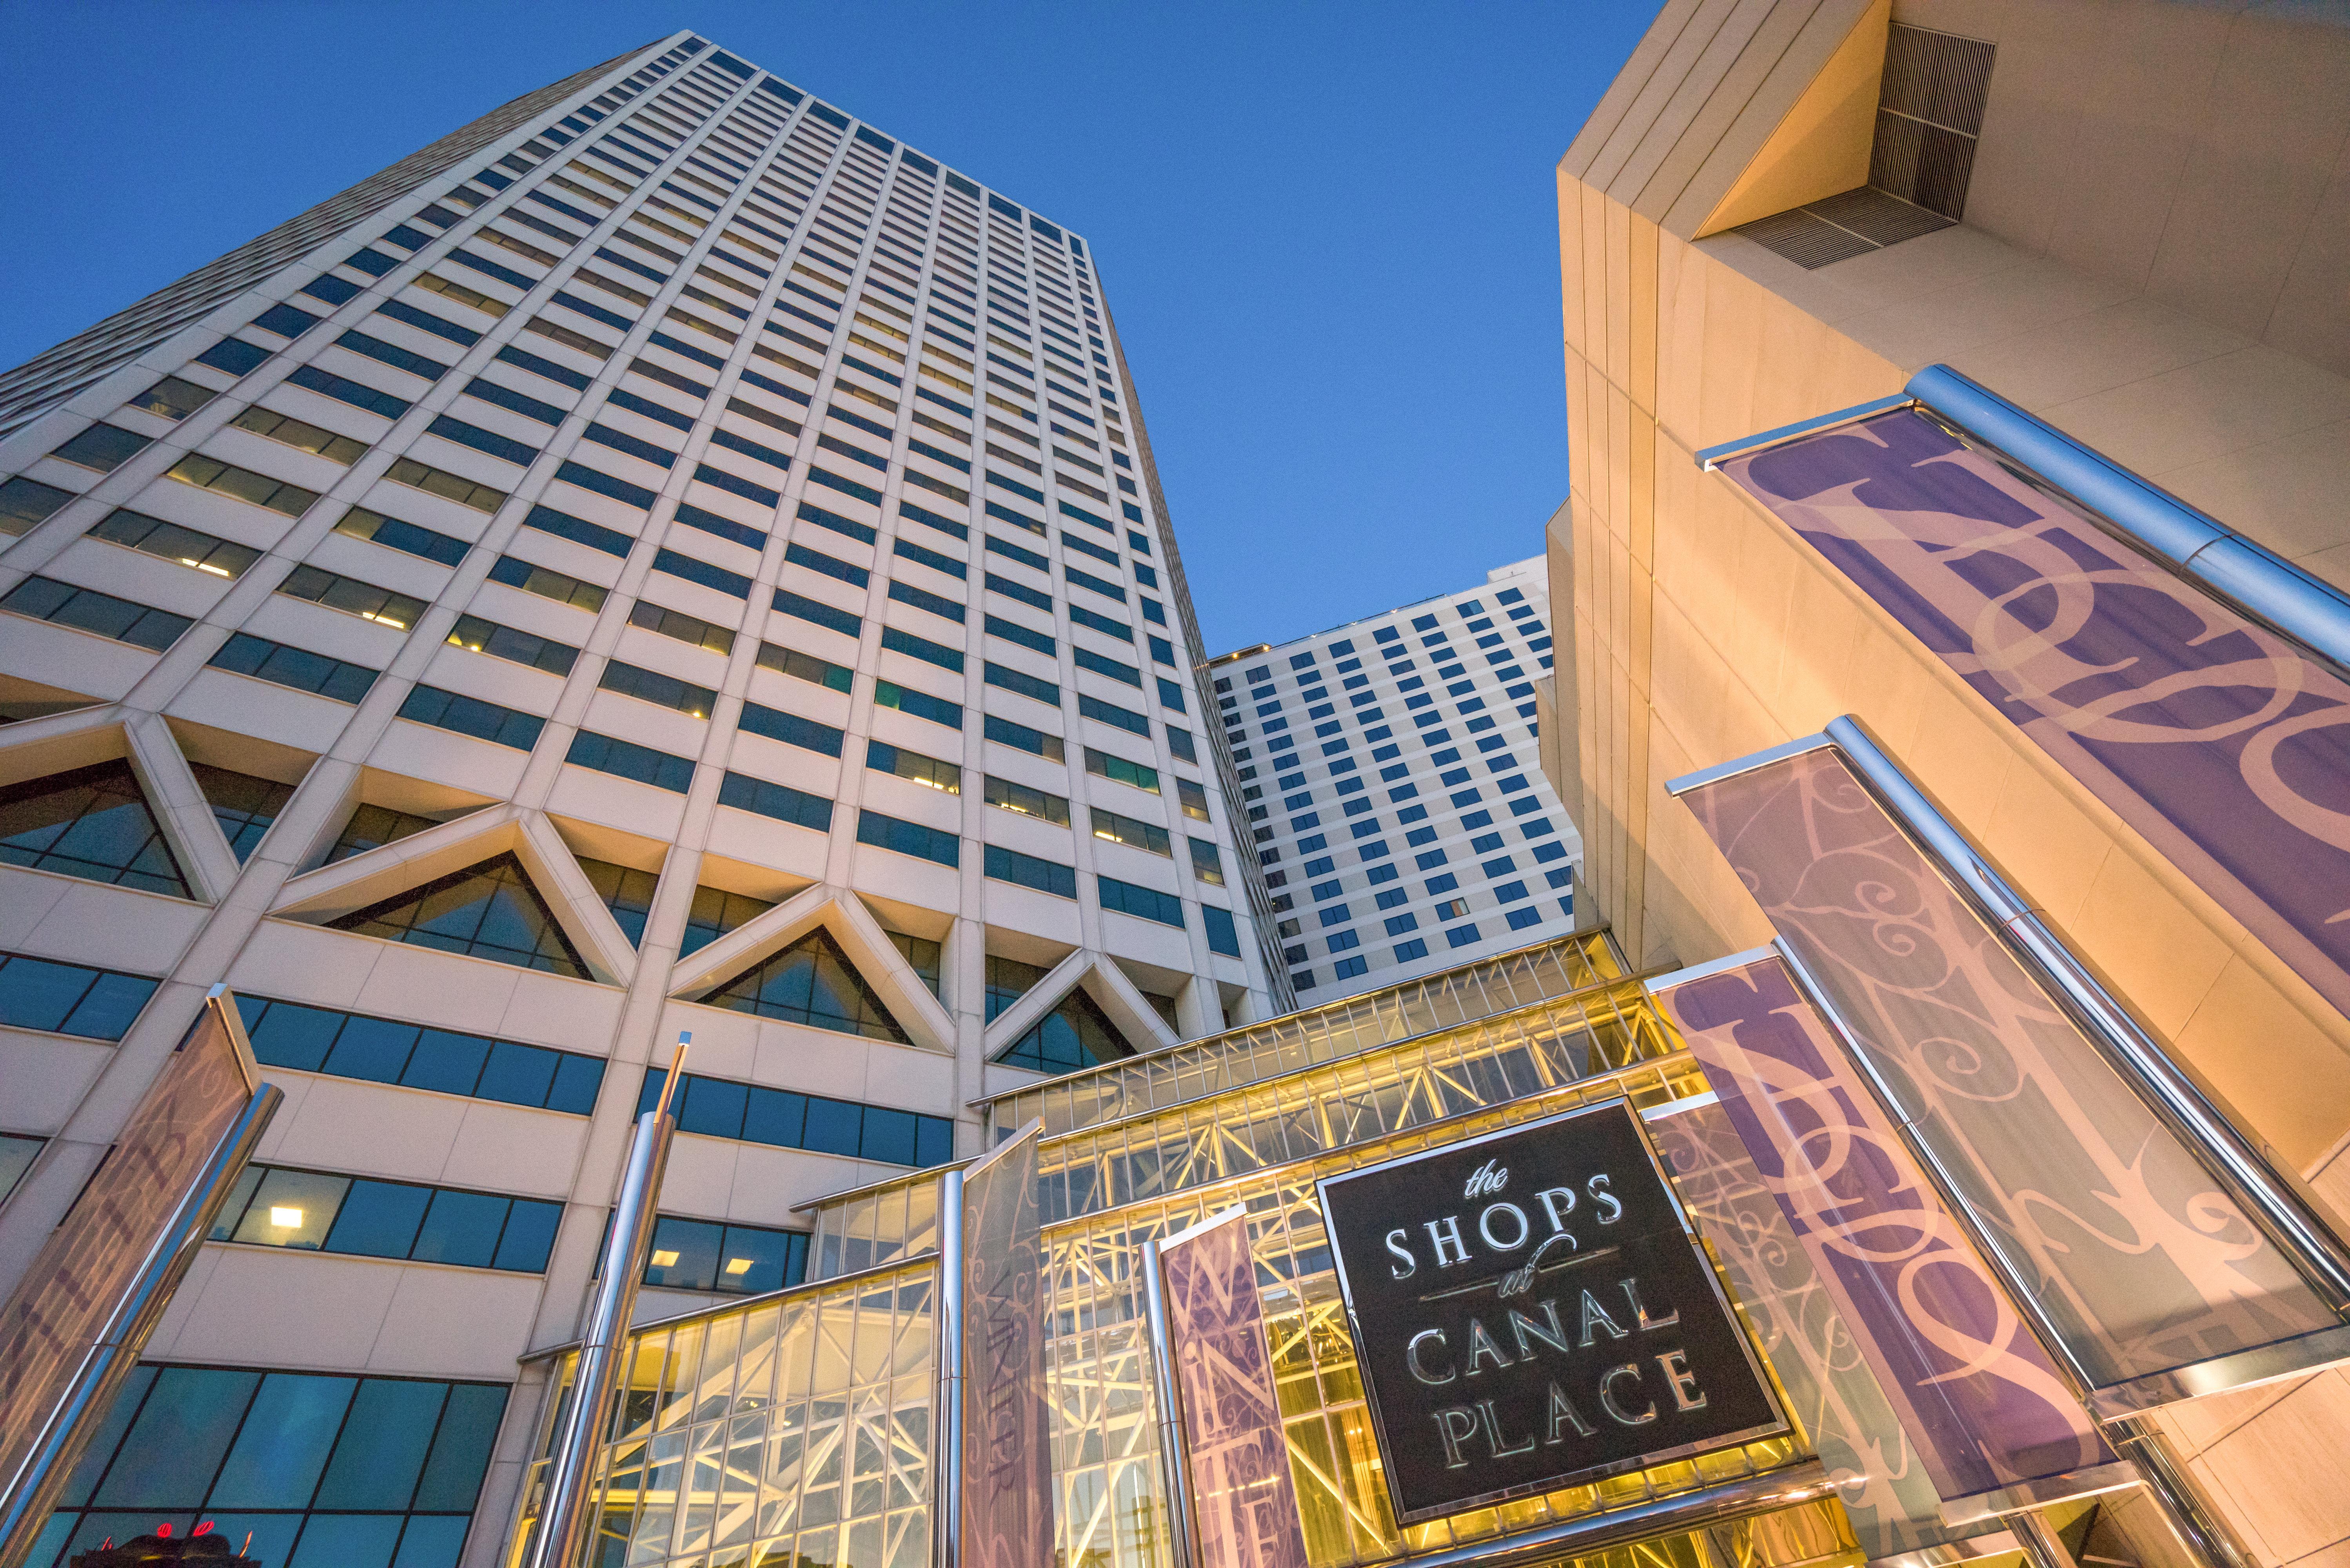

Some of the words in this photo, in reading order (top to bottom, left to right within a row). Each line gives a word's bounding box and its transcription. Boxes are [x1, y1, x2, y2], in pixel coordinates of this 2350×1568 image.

[1385, 1174, 1623, 1280] SHOPS
[1464, 1158, 1509, 1200] the
[1498, 1234, 1577, 1297] at
[1407, 1278, 1680, 1385] CANAL
[986, 1267, 1017, 1512] WINTER
[1432, 1349, 1708, 1469] PLACE
